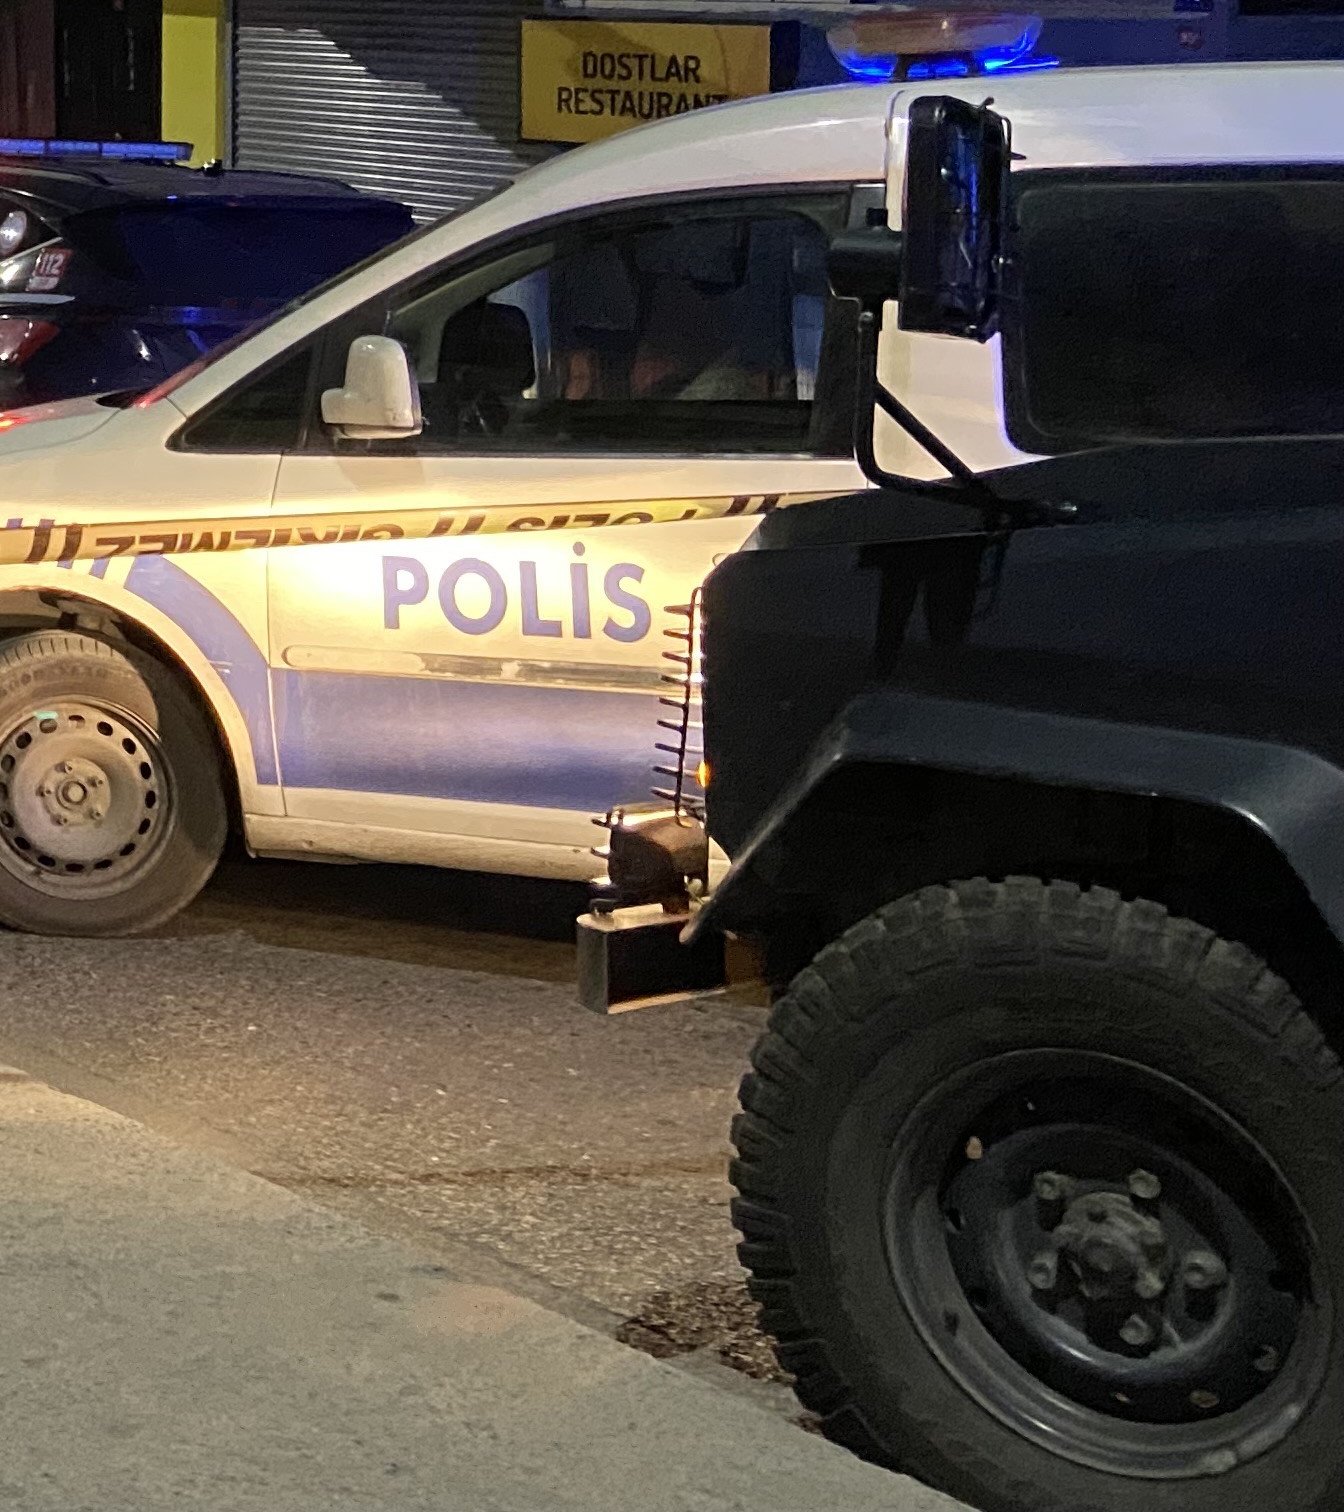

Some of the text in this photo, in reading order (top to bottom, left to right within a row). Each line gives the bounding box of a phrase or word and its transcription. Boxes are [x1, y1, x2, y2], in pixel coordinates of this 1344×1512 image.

[581, 50, 702, 84] DOSTLAR
[556, 86, 729, 120] RESTAURAN
[39, 252, 64, 276] 112
[382, 541, 652, 643] POLİS
